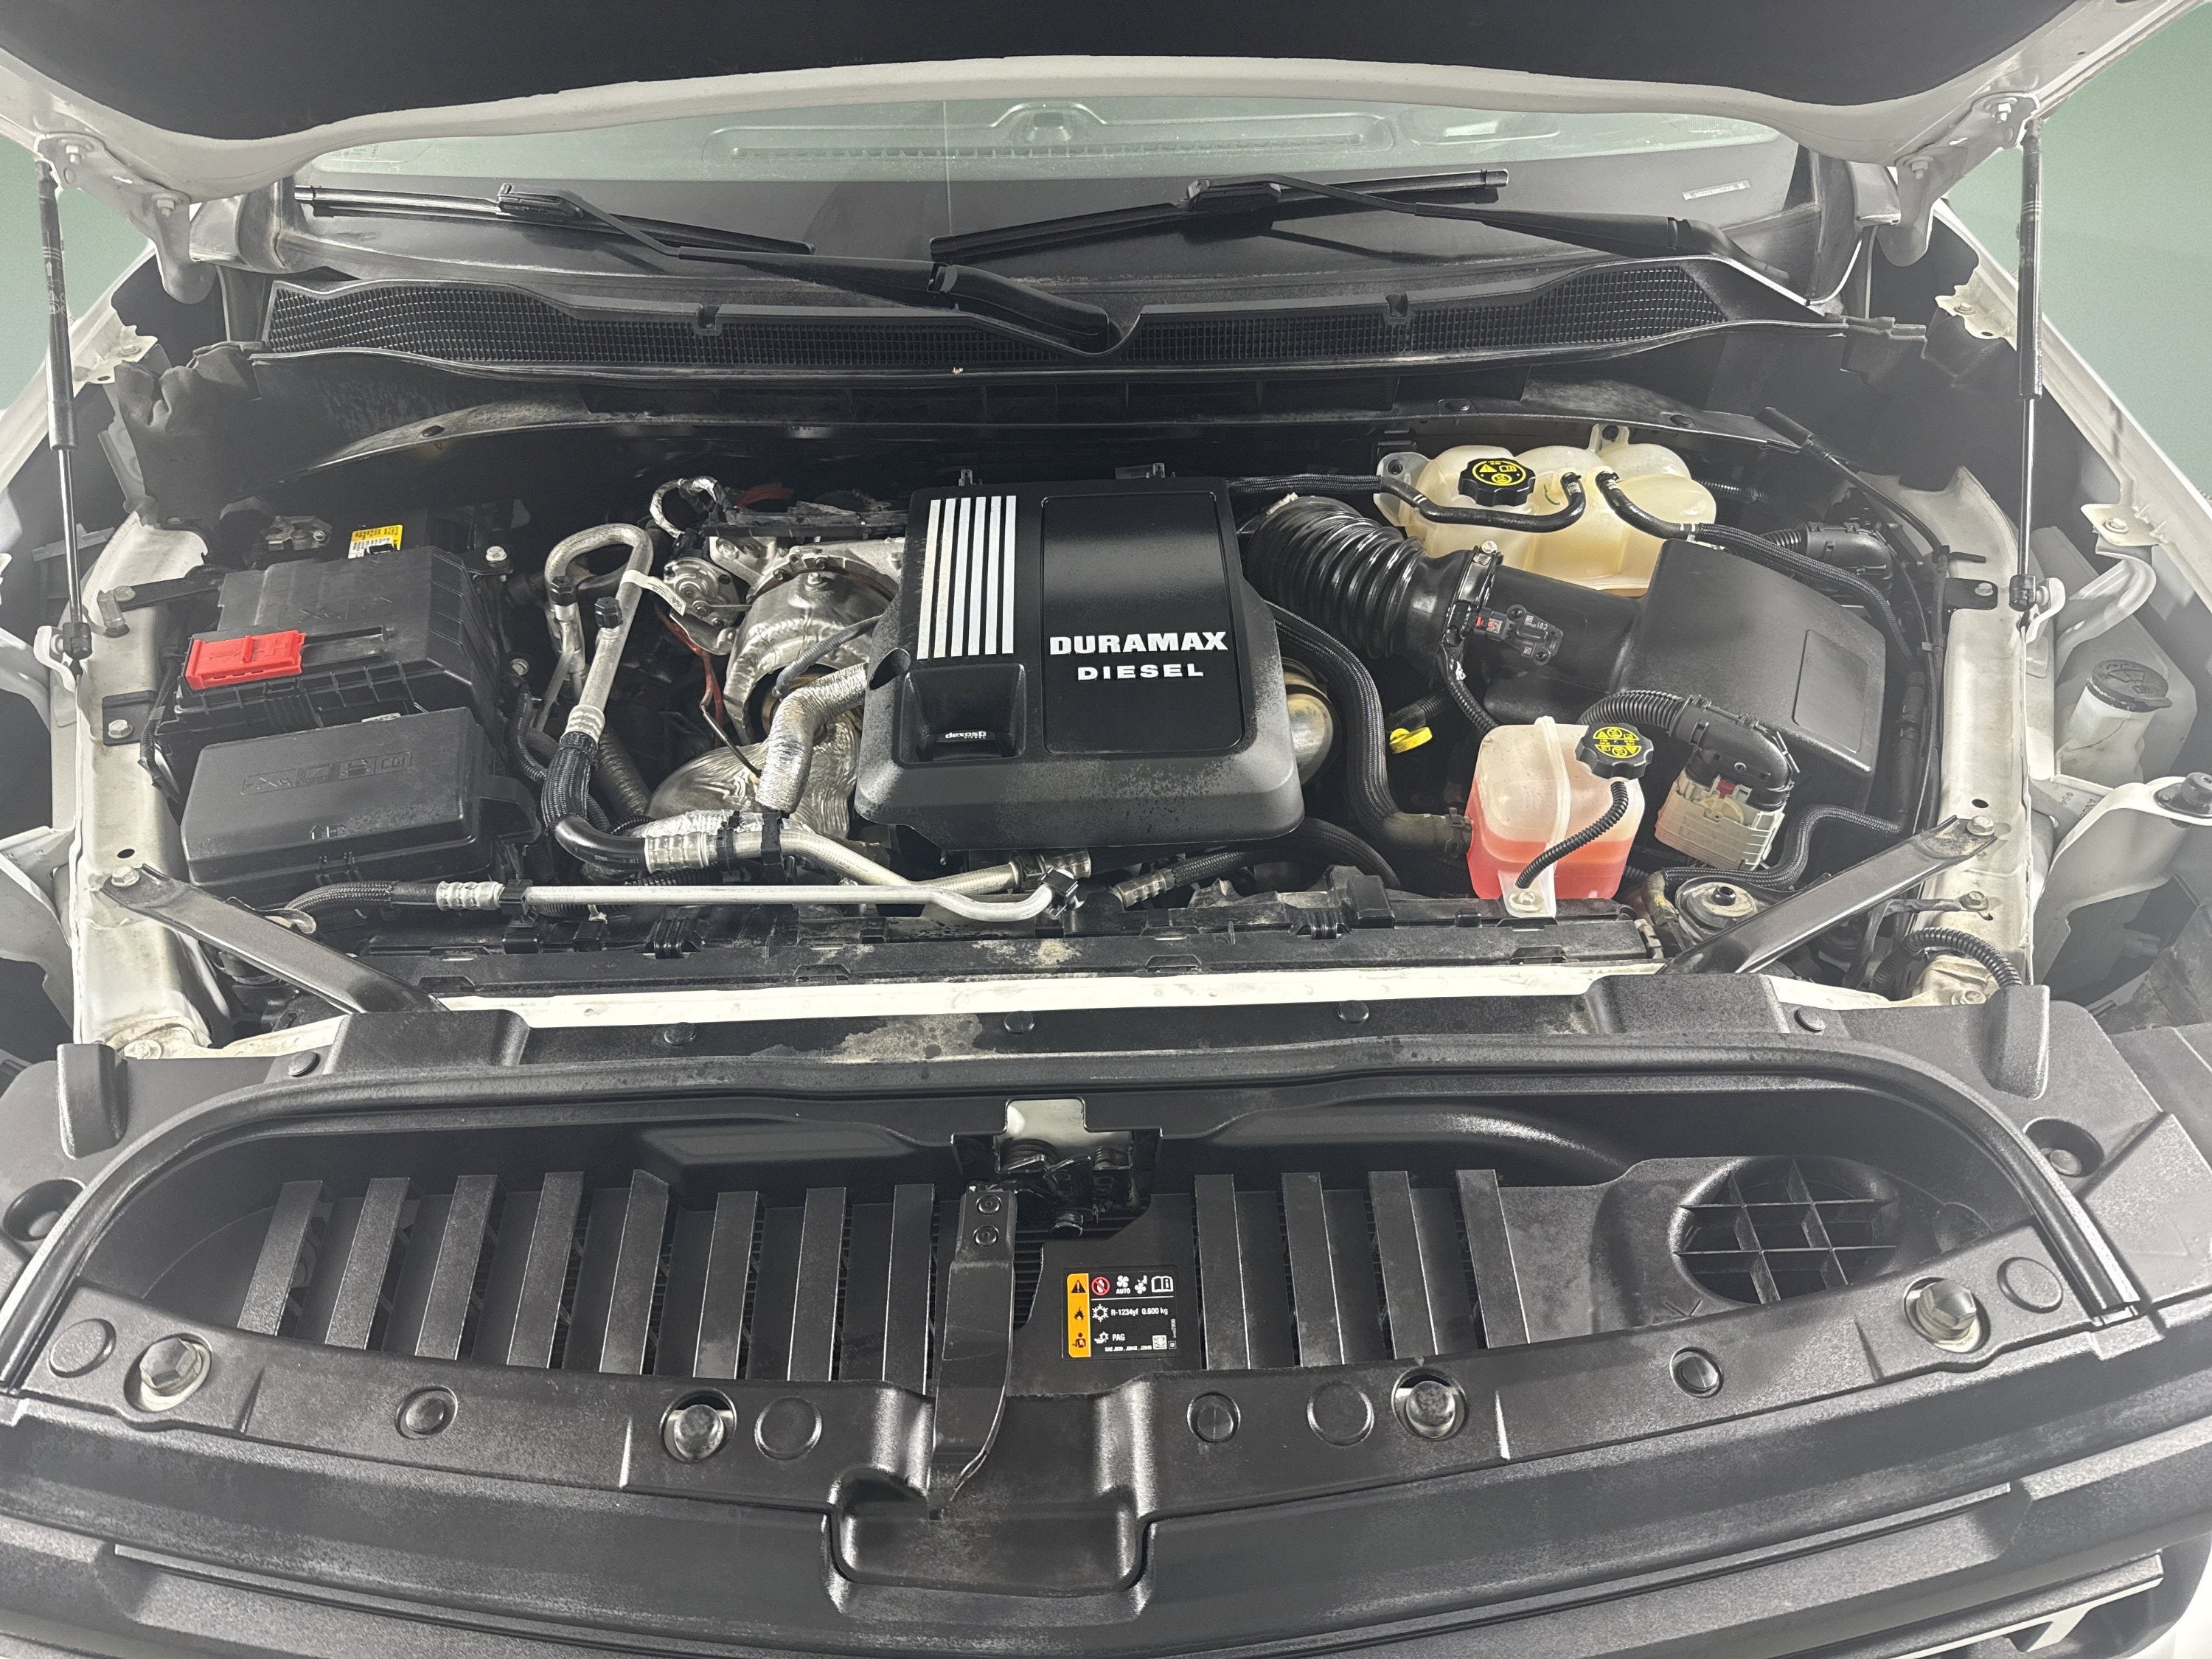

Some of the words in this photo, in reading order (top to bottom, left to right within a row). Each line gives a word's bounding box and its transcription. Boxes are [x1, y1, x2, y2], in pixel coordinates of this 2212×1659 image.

[1049, 631, 1228, 655] DURAMAX
[1077, 664, 1204, 681] DIESEL
[1110, 1309, 1138, 1317] R-1234yf
[1141, 1307, 1159, 1315] 0.600
[1160, 1307, 1169, 1315] kg
